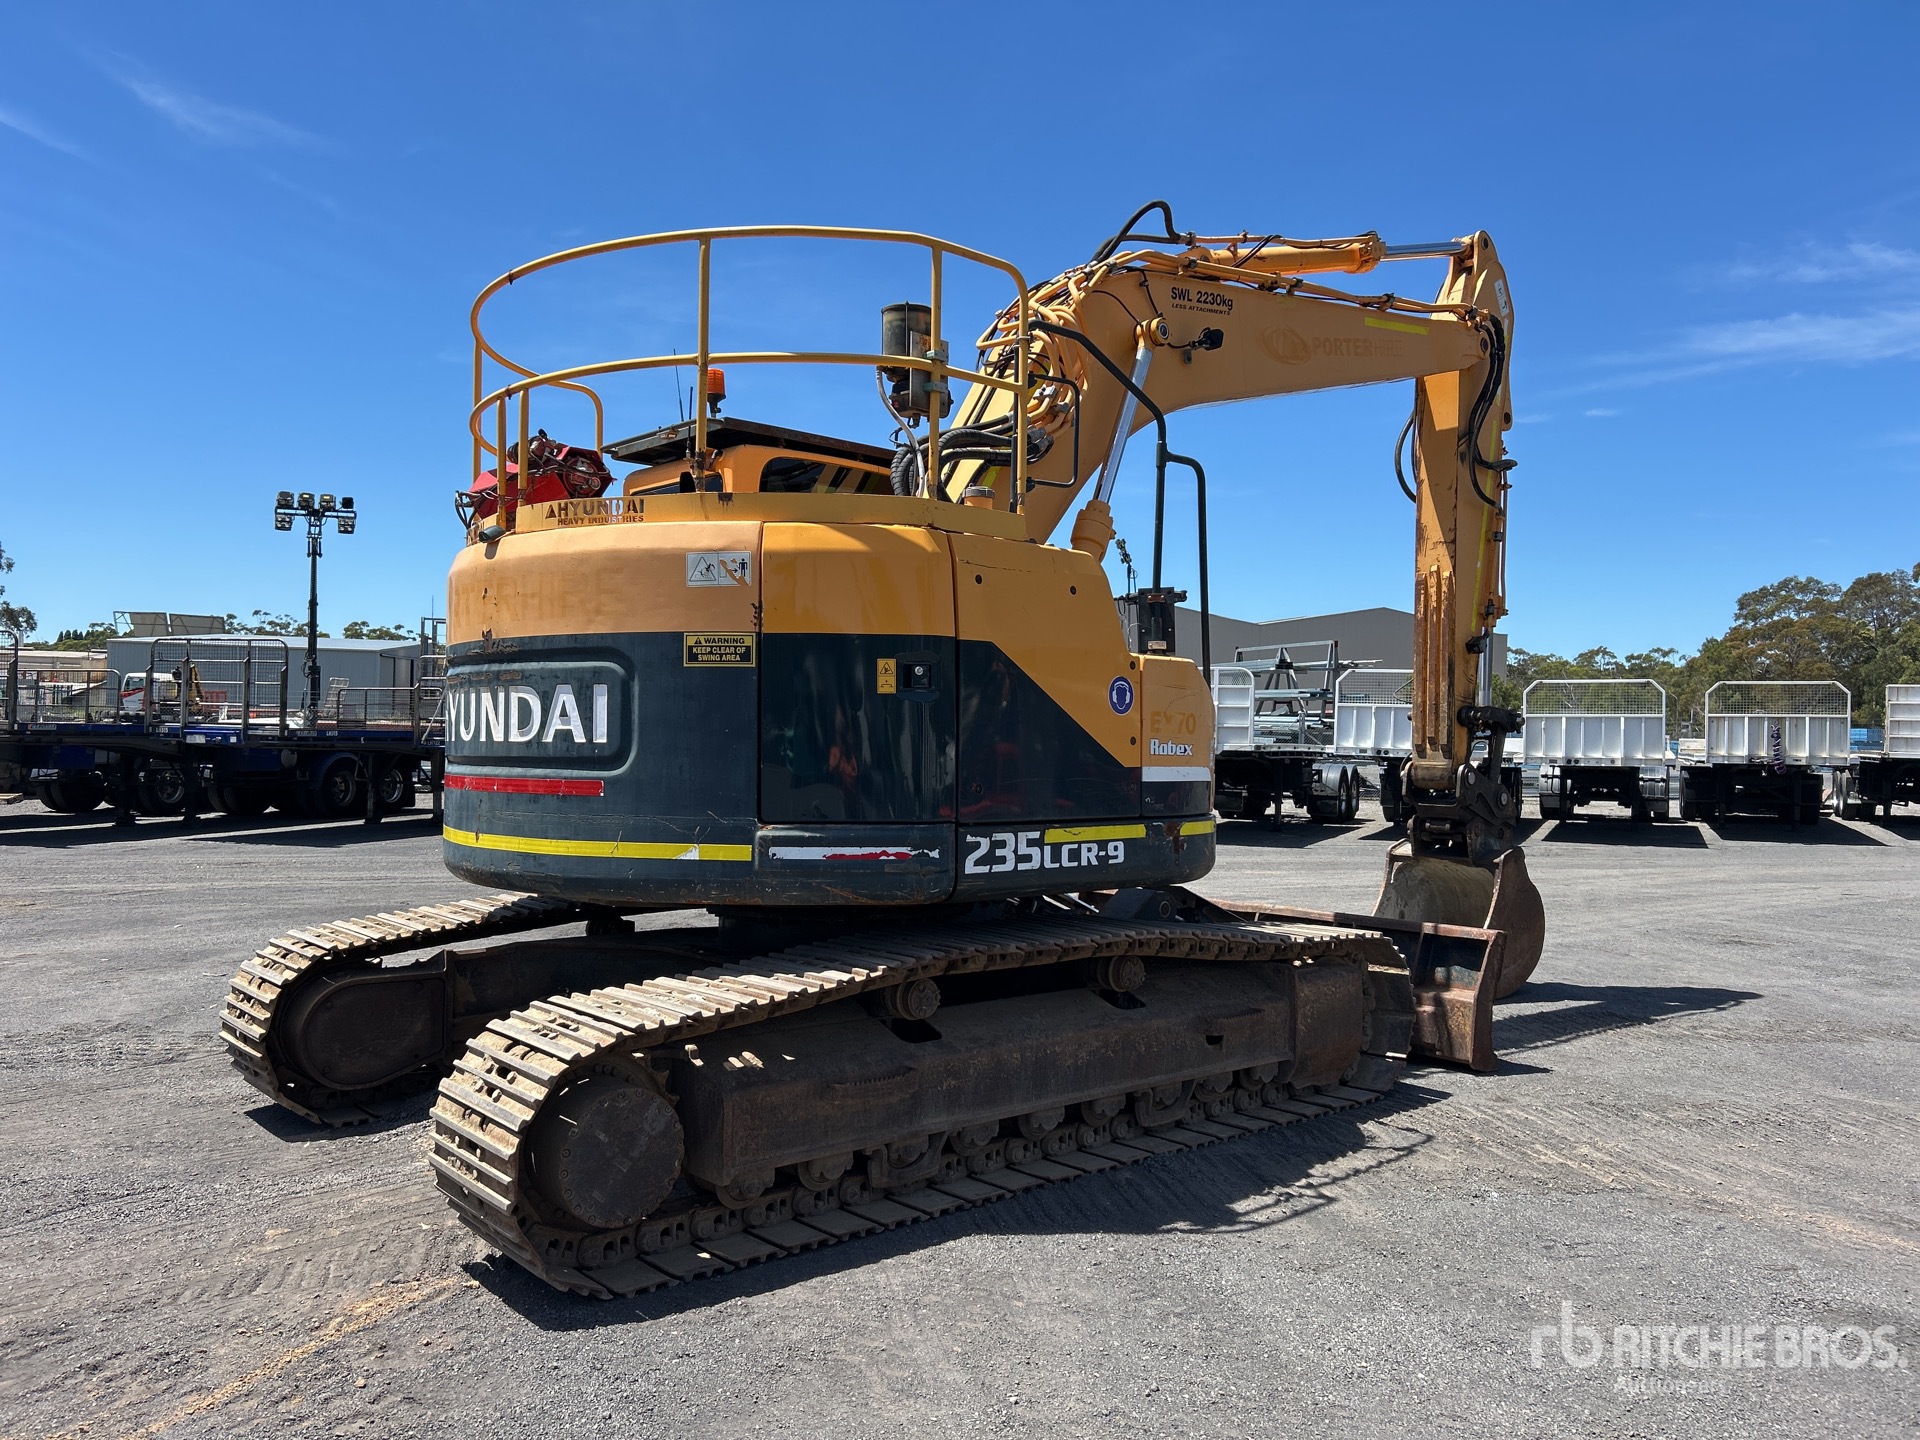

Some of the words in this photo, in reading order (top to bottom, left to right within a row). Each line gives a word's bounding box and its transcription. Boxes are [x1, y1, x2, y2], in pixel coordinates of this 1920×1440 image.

[1171, 287, 1193, 302] SWL
[1196, 290, 1233, 311] 2230kg
[1188, 306, 1231, 316] ATTACHMENTS
[557, 499, 645, 517] HYUNDAI
[557, 516, 584, 526] HEAVY
[588, 515, 644, 525] INDUSTRIES
[703, 637, 745, 645] WARNING
[692, 646, 711, 654] KEEP
[712, 646, 735, 654] CLEAR
[446, 684, 608, 743] YUNDAI
[1149, 738, 1194, 756] Robex
